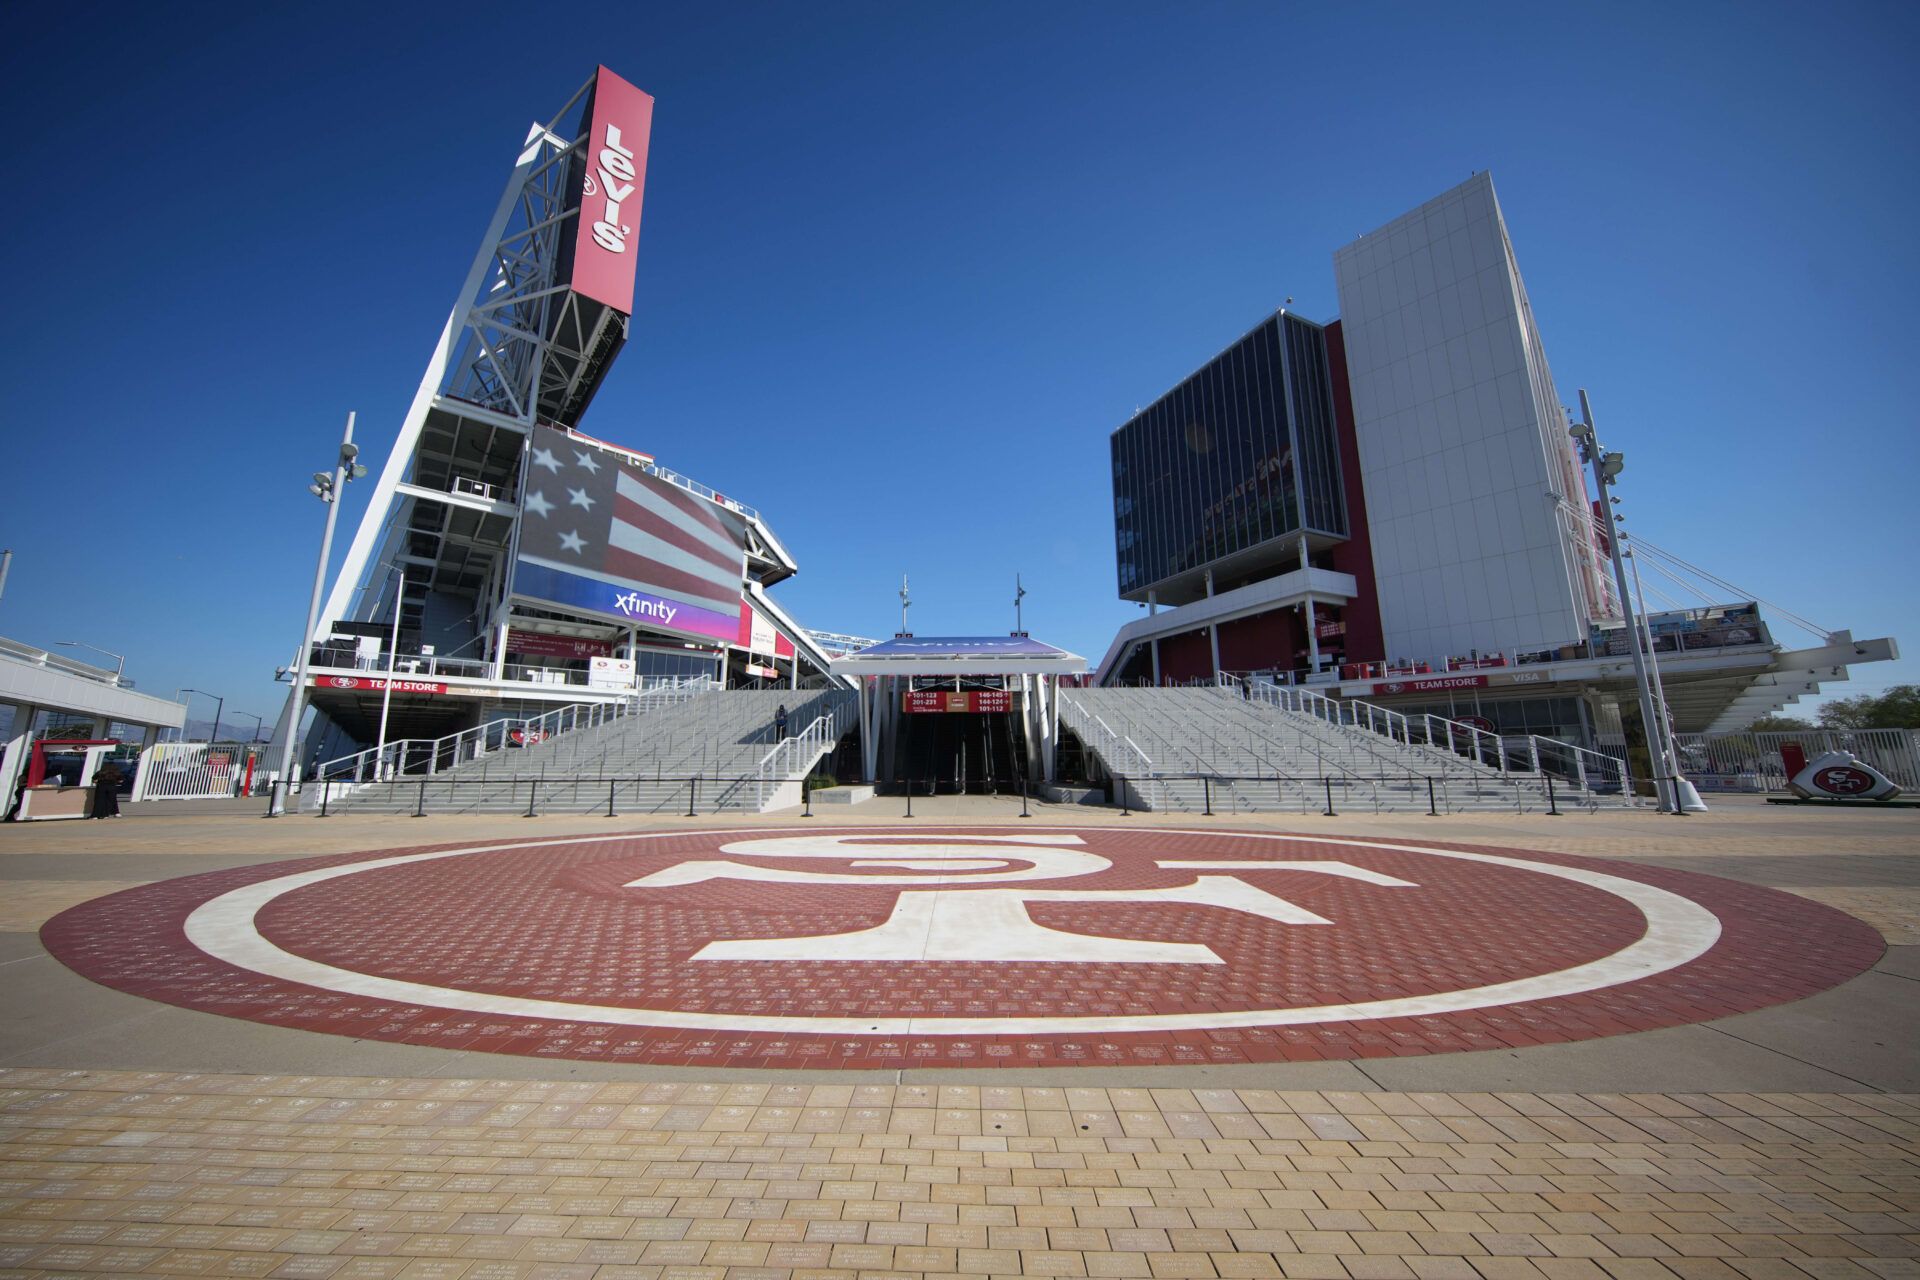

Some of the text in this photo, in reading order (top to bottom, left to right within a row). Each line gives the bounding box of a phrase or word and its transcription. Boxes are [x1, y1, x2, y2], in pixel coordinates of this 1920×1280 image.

[614, 592, 677, 624] xfinity
[1512, 672, 1539, 682] VISA
[403, 682, 438, 692] STORE
[1414, 680, 1443, 690] TEAM
[1444, 678, 1478, 688] STORE
